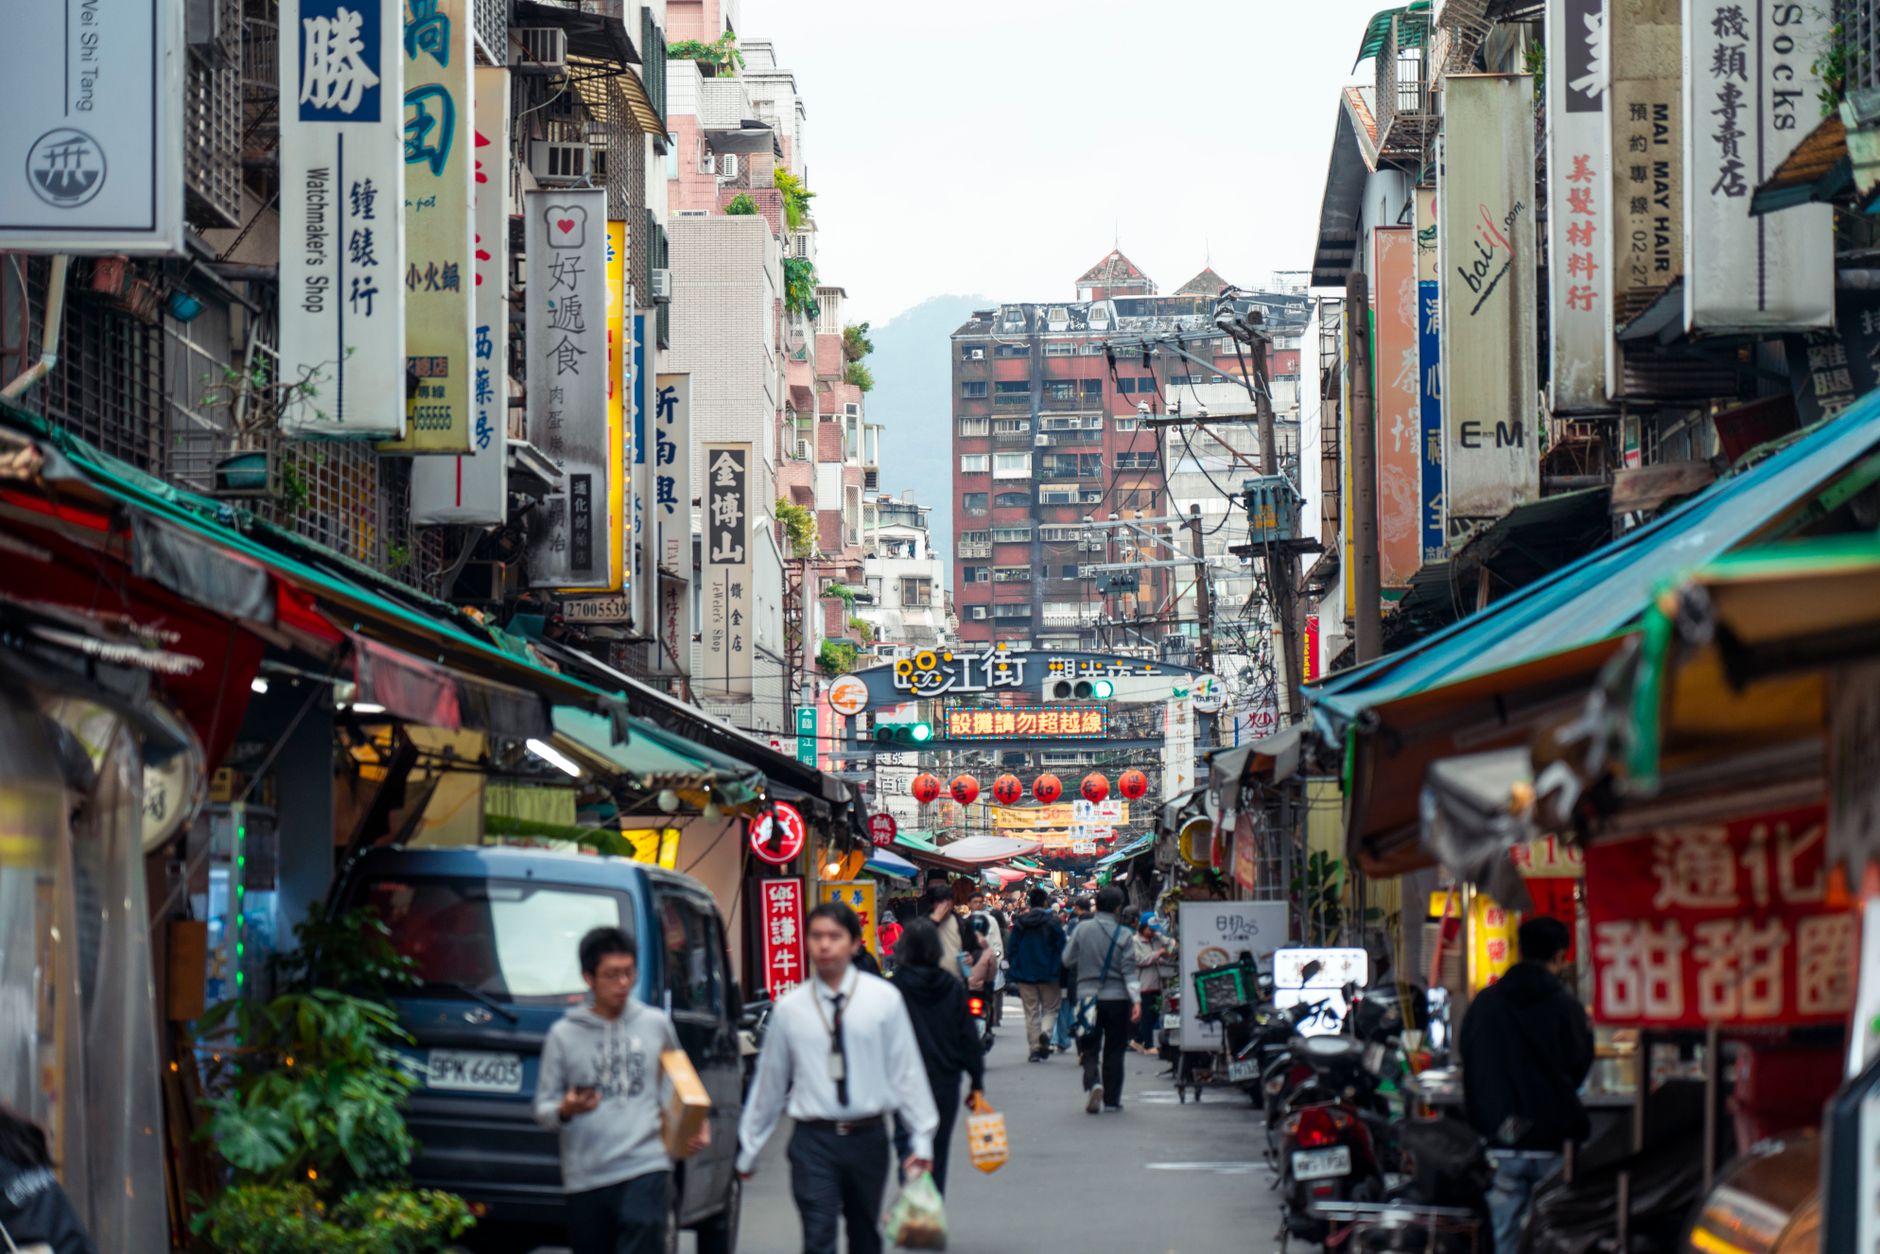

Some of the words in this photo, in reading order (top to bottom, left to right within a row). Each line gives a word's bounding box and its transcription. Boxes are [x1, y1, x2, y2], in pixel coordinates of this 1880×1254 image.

[80, 32, 99, 62] Shi
[300, 7, 380, 114] 勝
[1772, 3, 1804, 132] Socks
[75, 66, 99, 112] Tang
[1652, 103, 1669, 145] MAI
[1653, 160, 1671, 208] MAY
[305, 167, 330, 265] Watchmaker's
[1566, 154, 1599, 312] 美髮材料行
[1654, 216, 1671, 273] HAIR
[301, 275, 329, 314] Shop
[710, 451, 745, 562] 金博山
[950, 712, 1103, 736] 設攤請勿超越線
[1036, 779, 1054, 797] 如
